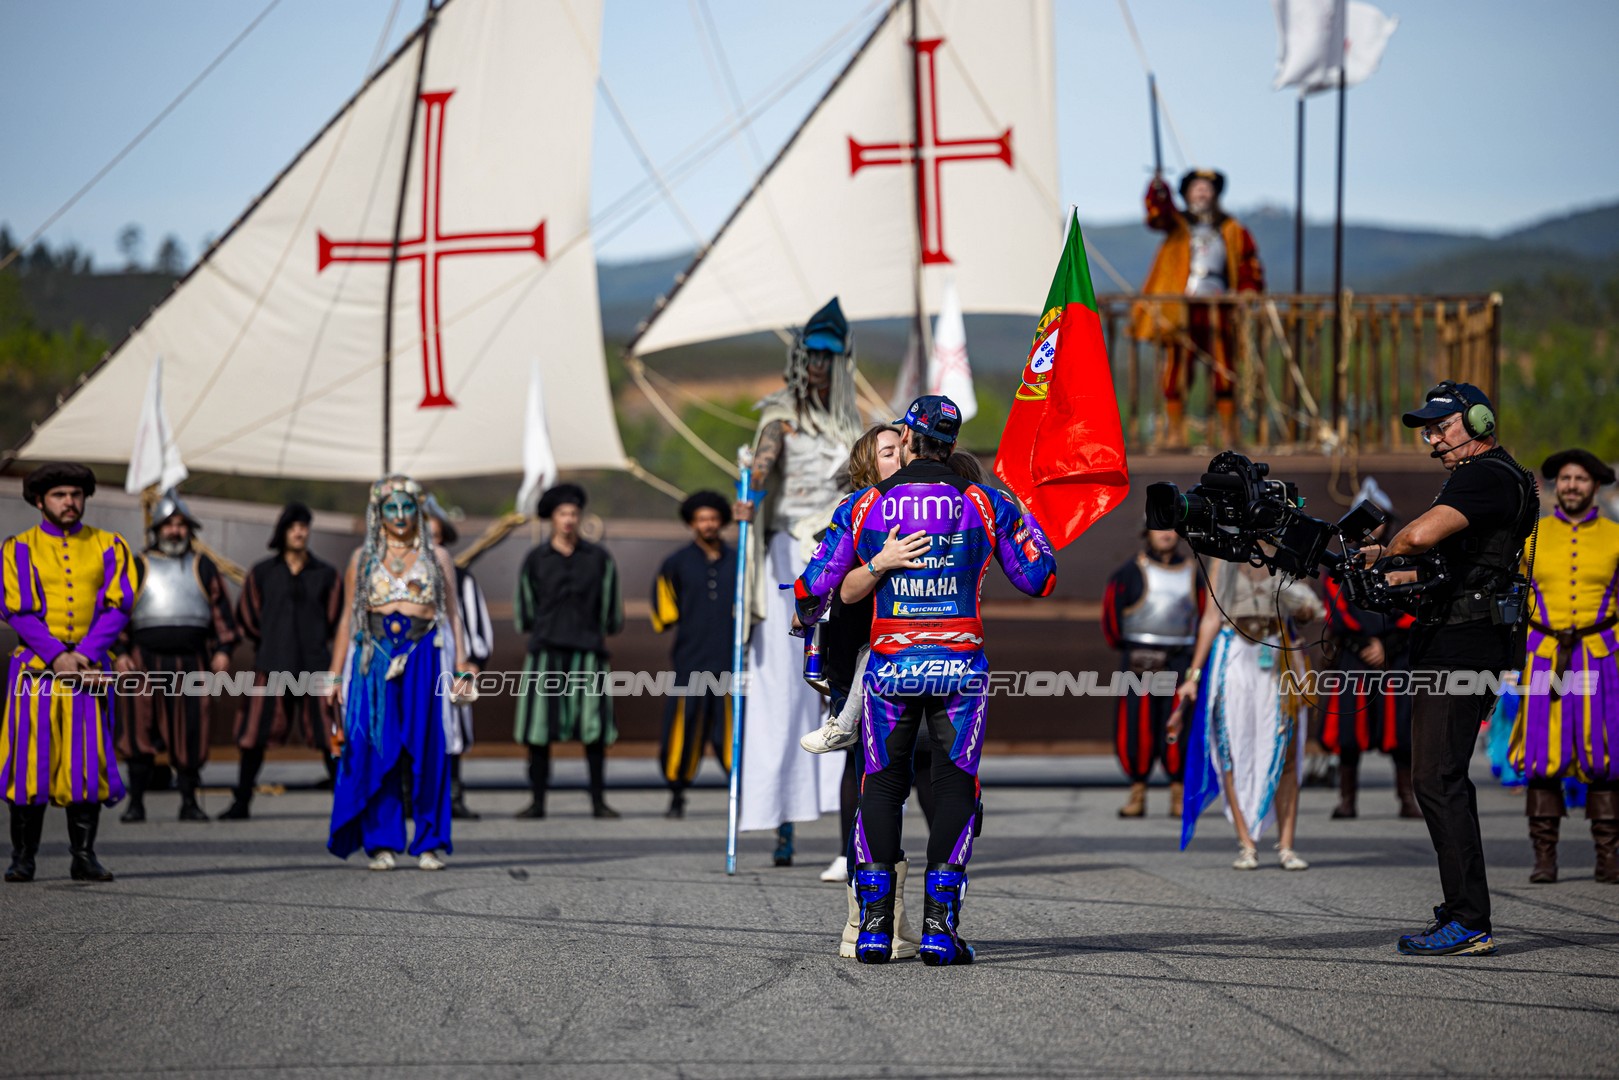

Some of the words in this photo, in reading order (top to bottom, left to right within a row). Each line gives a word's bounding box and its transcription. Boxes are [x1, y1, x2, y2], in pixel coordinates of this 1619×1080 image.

[881, 495, 963, 521] prima
[890, 576, 958, 597] YAMAHA
[910, 604, 953, 613] MICHELIN
